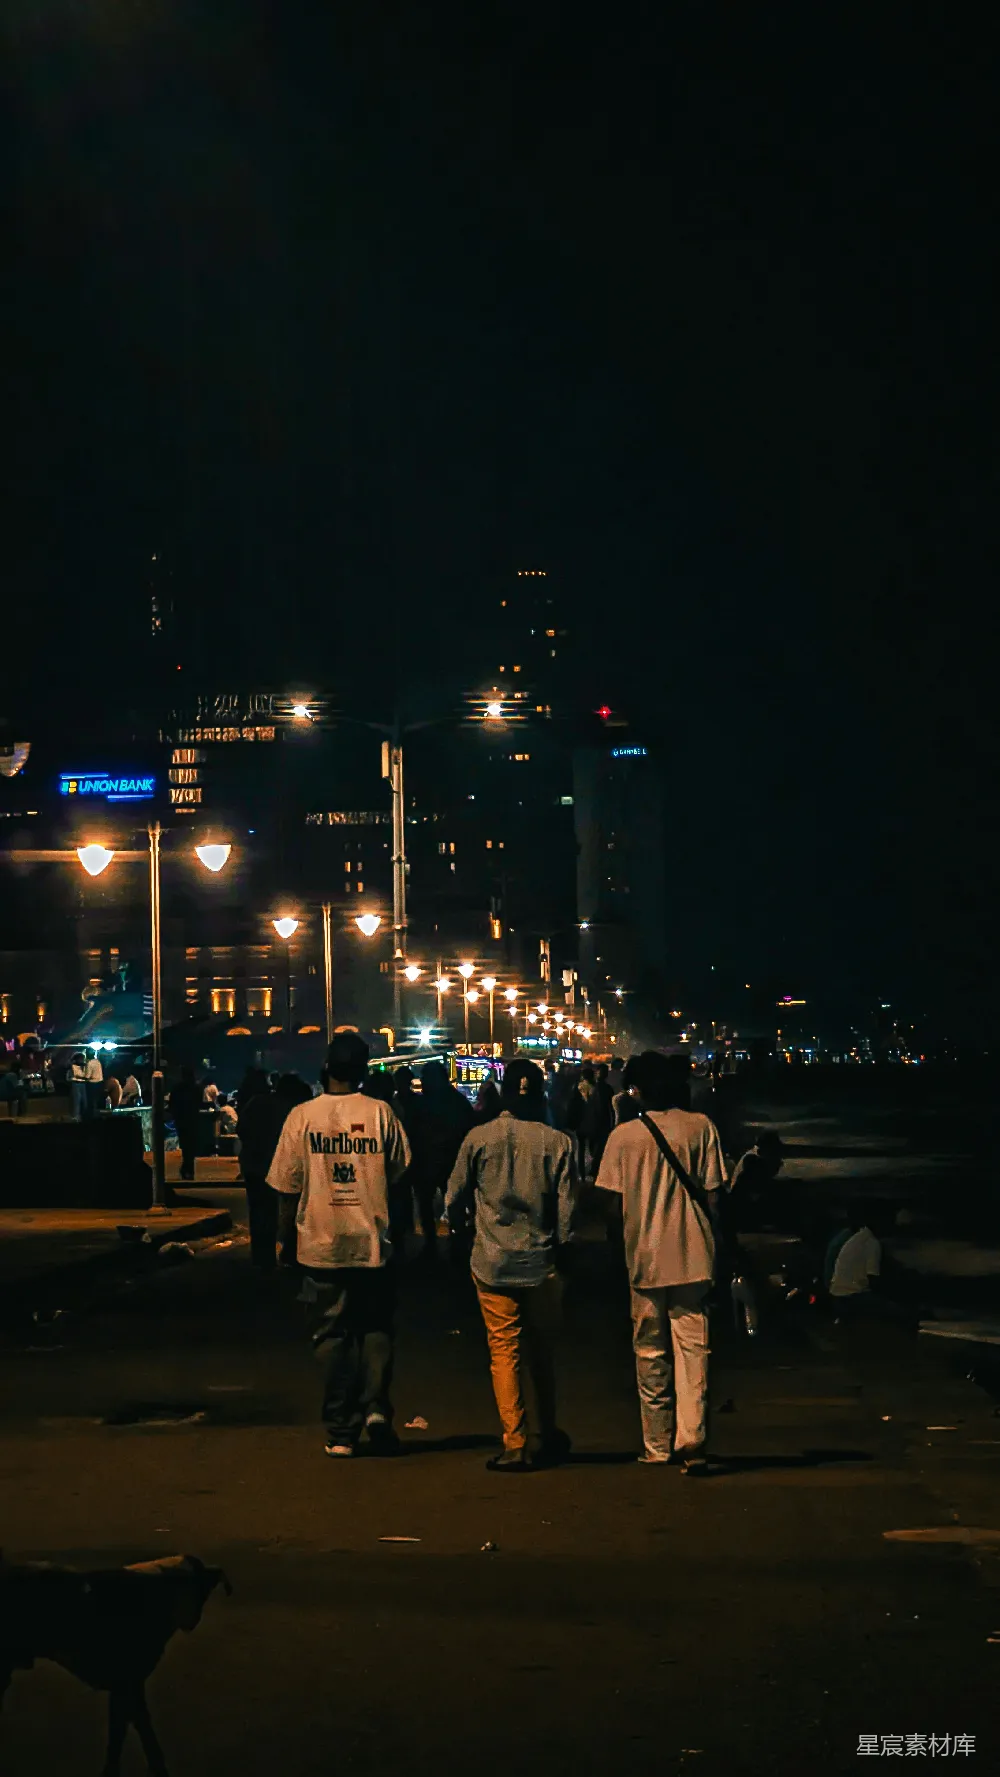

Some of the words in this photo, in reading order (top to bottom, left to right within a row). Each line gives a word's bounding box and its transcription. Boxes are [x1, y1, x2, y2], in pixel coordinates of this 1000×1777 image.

[79, 780, 119, 792] UNION
[119, 778, 154, 791] BANK
[309, 1132, 378, 1154] Marlboro
